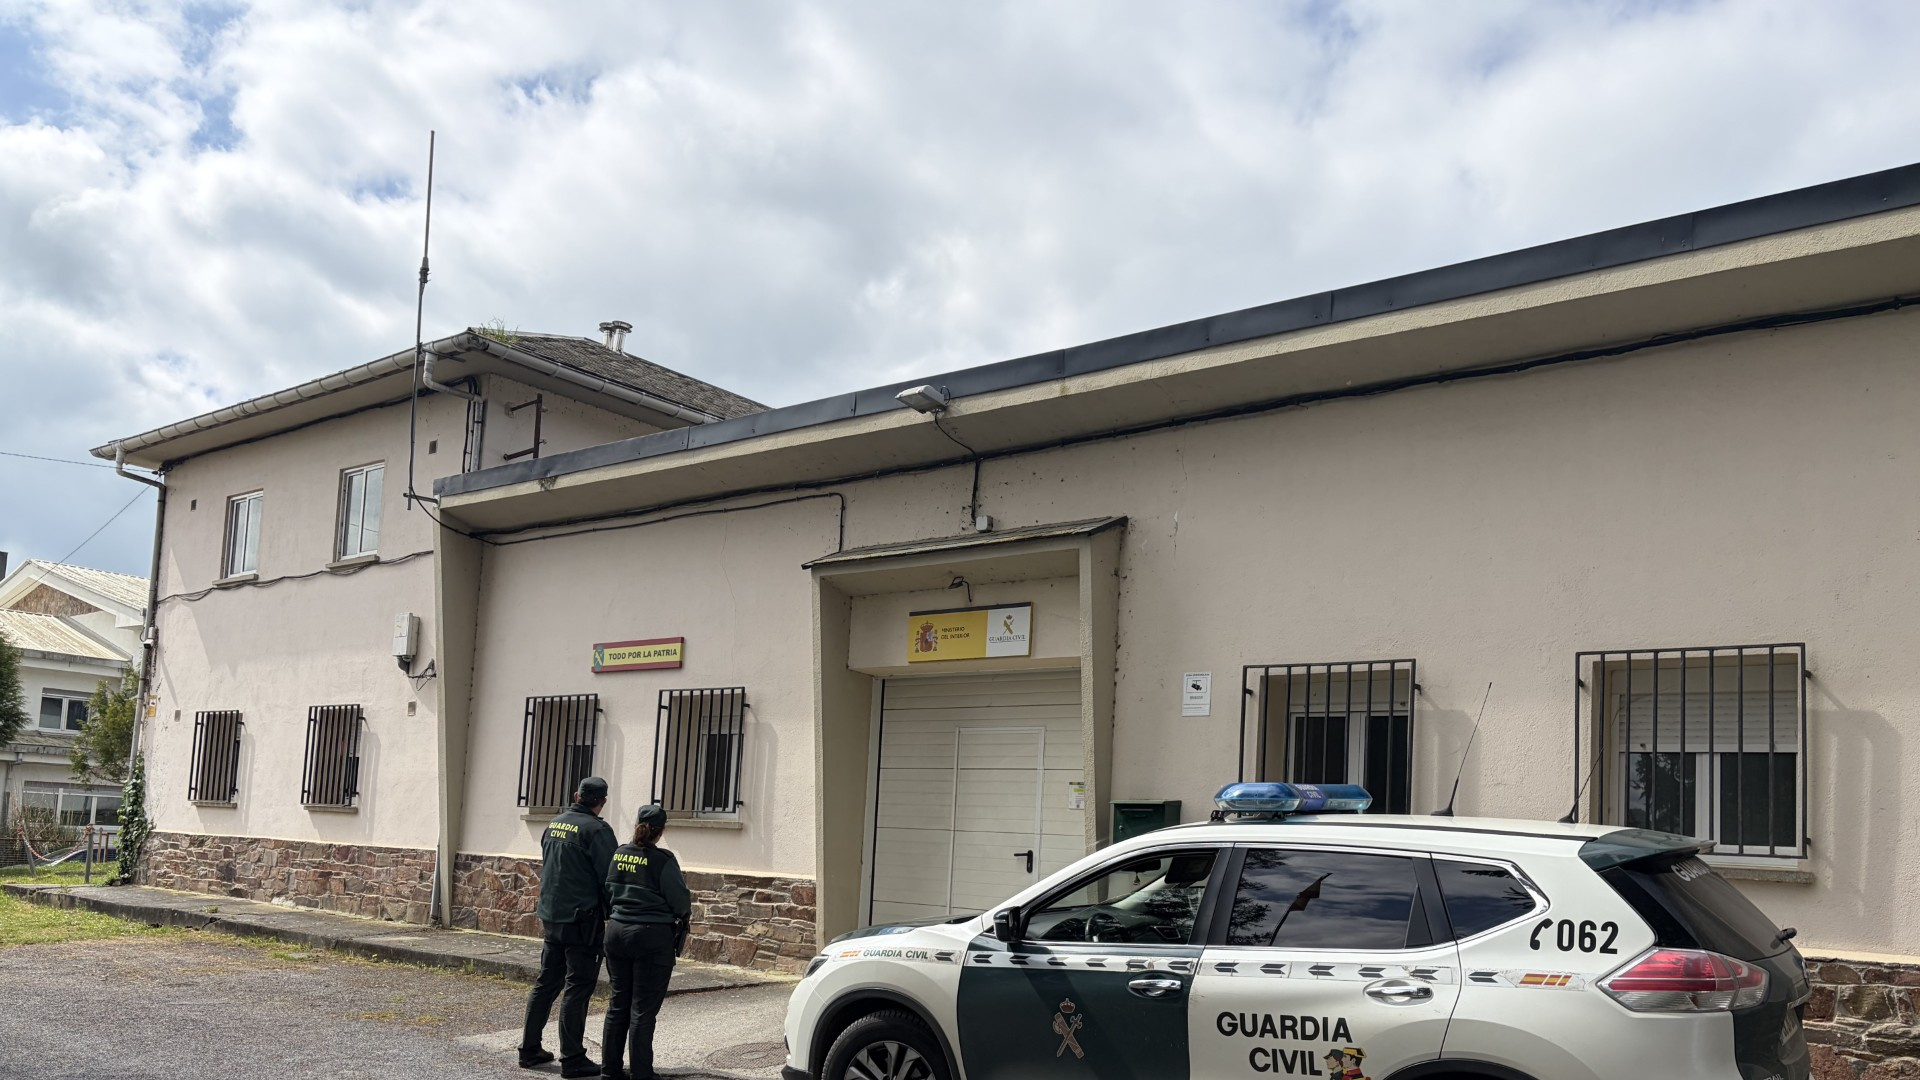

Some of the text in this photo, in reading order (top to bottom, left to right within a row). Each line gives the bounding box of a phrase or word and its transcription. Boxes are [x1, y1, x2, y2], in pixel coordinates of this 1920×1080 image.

[608, 648, 678, 661] TODO POR LA PATRIA
[548, 822, 579, 833] GUARDIA
[550, 829, 567, 839] CIVIL
[613, 853, 648, 866] GUARDIA
[617, 863, 637, 873] CIVIL
[1556, 918, 1619, 955] 062
[863, 949, 928, 960] GUARDIA CIVIL
[1216, 1011, 1353, 1043] GUARDIA
[1249, 1047, 1322, 1076] CIVIL
